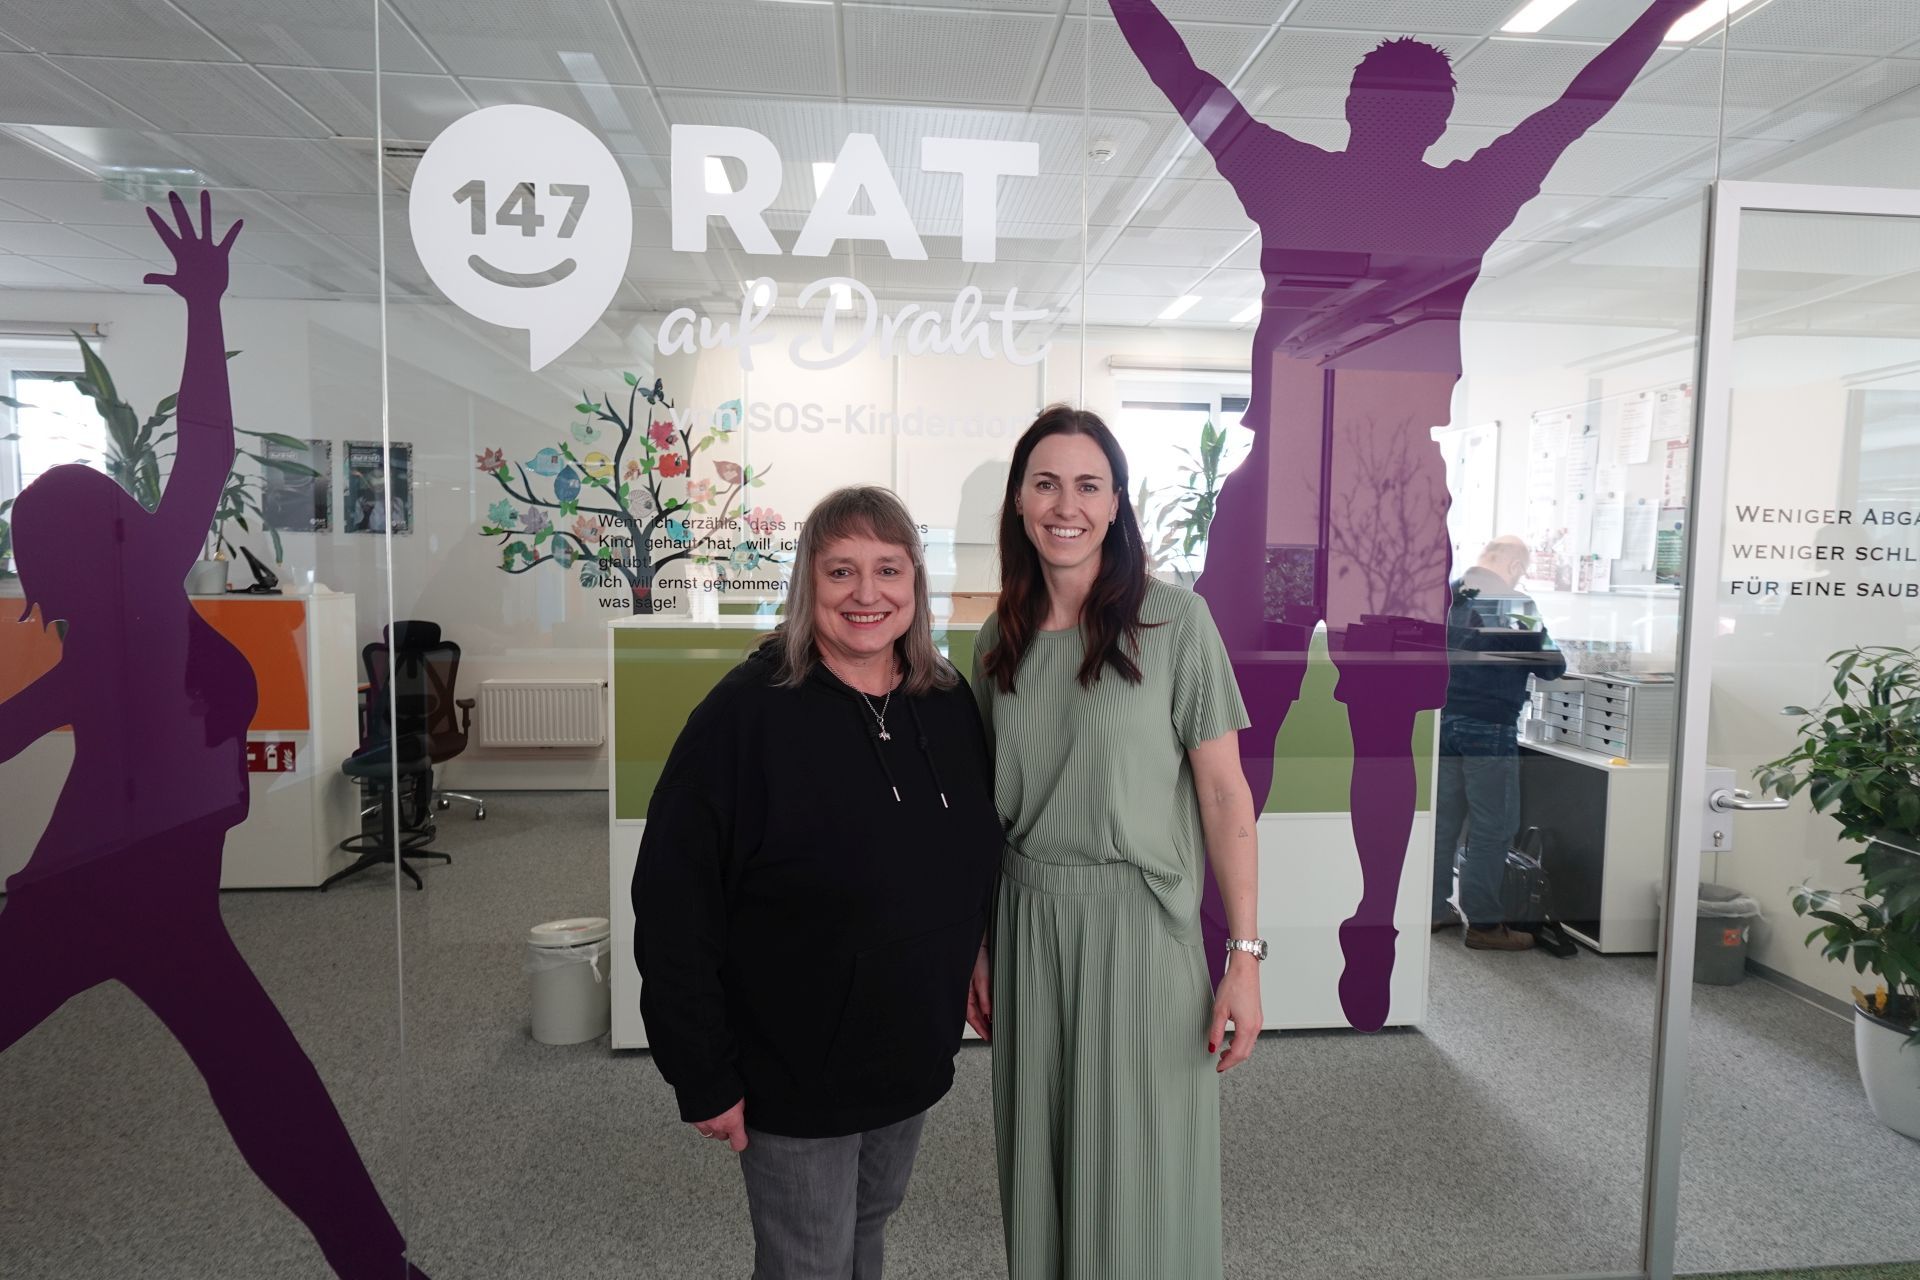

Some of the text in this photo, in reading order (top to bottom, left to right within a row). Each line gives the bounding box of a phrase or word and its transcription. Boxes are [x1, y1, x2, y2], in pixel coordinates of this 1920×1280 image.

[671, 124, 1039, 263] RAT
[452, 179, 590, 239] 147
[658, 277, 1052, 371] auf Draht
[748, 402, 1040, 438] SOS-Kinderdor
[599, 515, 642, 528] Wenn
[651, 515, 673, 529] ich
[682, 517, 741, 532] erzähle,
[750, 518, 786, 531] dass
[600, 535, 633, 548] Kind
[645, 536, 698, 551] gehaut
[708, 537, 736, 552] hat,
[746, 538, 770, 550] will
[1732, 545, 1845, 560] WENIGER
[599, 555, 652, 571] glaubt!
[600, 576, 789, 592] Ich will ernst genommen
[1730, 576, 1779, 595] FÜR
[1791, 582, 1846, 596] EINE
[599, 596, 676, 612] was sage!
